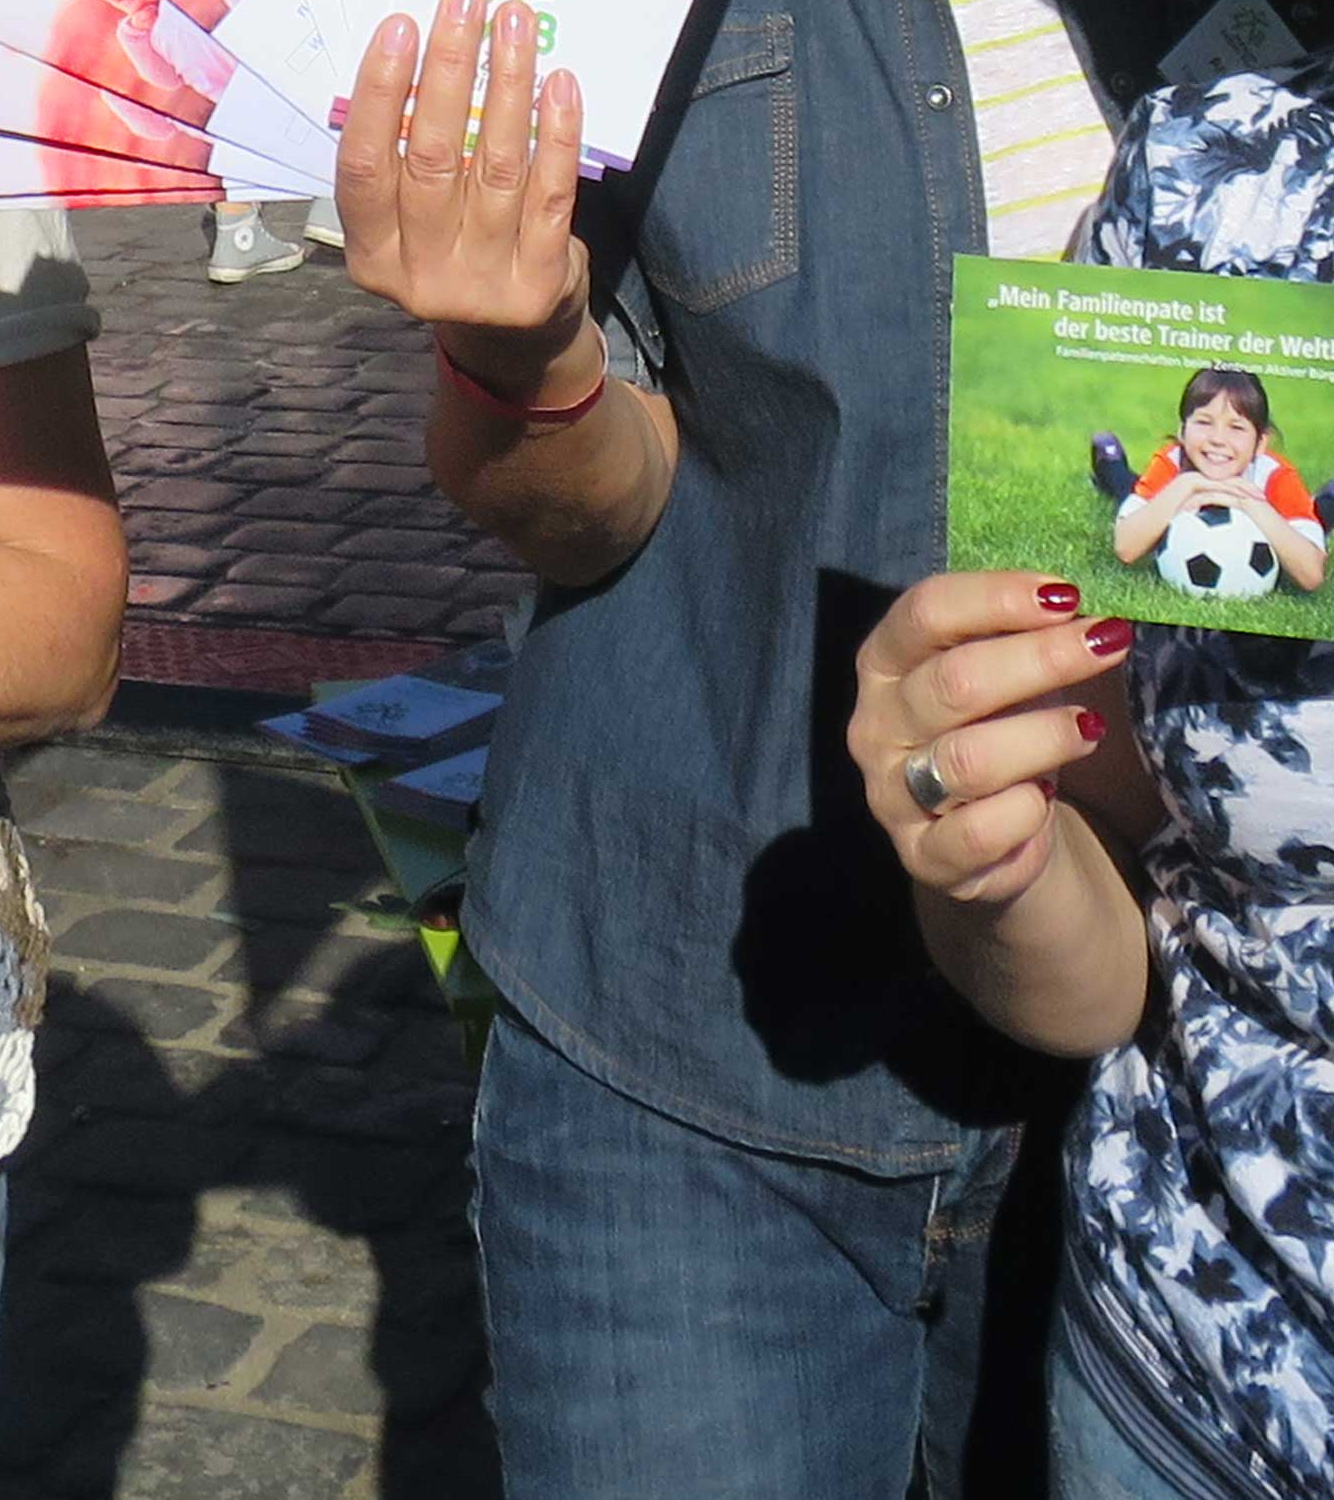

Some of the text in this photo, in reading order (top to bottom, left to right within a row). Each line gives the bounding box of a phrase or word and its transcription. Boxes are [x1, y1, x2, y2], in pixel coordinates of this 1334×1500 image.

[986, 284, 1227, 325] „Mein Familienpate ist
[1053, 316, 1089, 341] der
[1094, 318, 1153, 346] beste
[1157, 323, 1233, 353] Trainer
[1237, 329, 1276, 357] der
